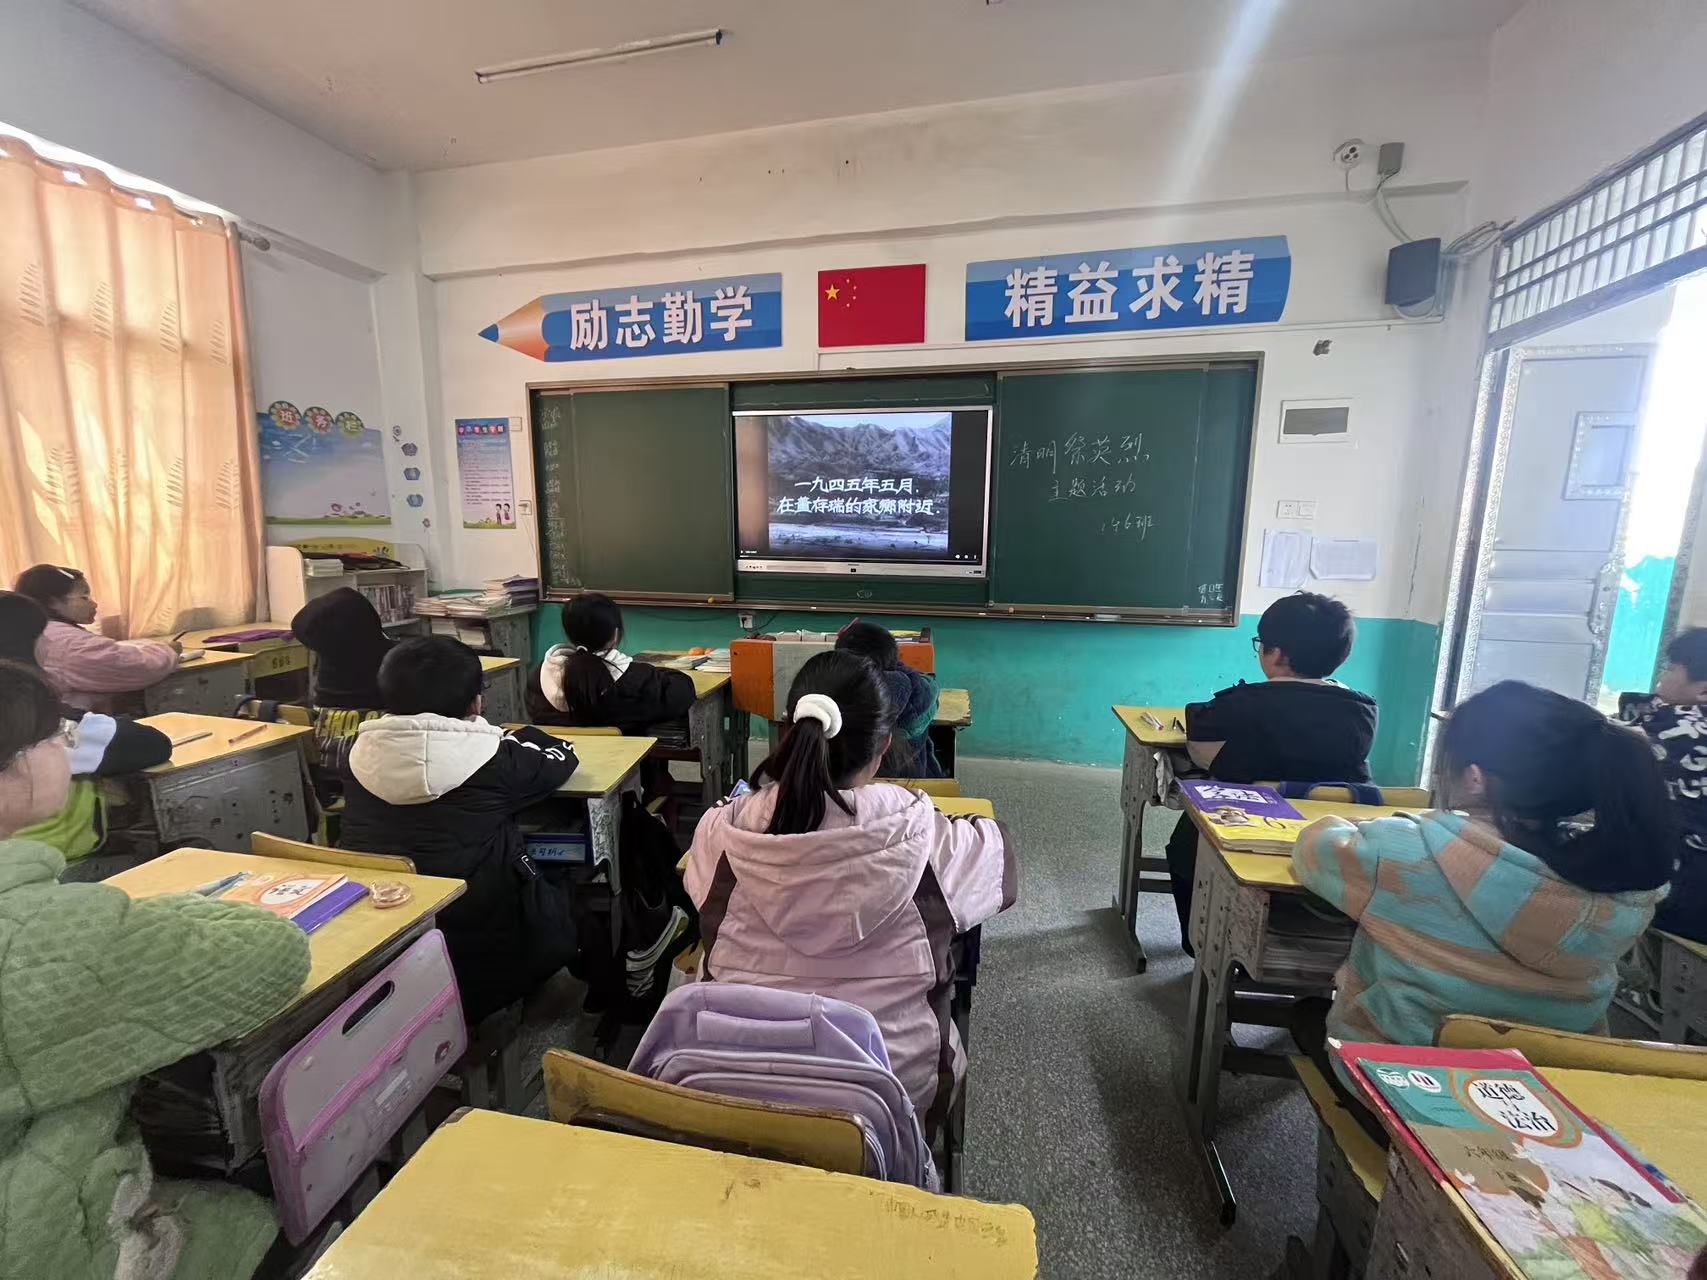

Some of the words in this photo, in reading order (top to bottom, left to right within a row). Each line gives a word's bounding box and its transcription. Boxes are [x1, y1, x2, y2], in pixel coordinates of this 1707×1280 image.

[1003, 250, 1256, 328] 精益求精
[569, 285, 753, 350] 励志勤学
[1048, 473, 1136, 502] 主题活动
[1499, 1110, 1557, 1132] 法治
